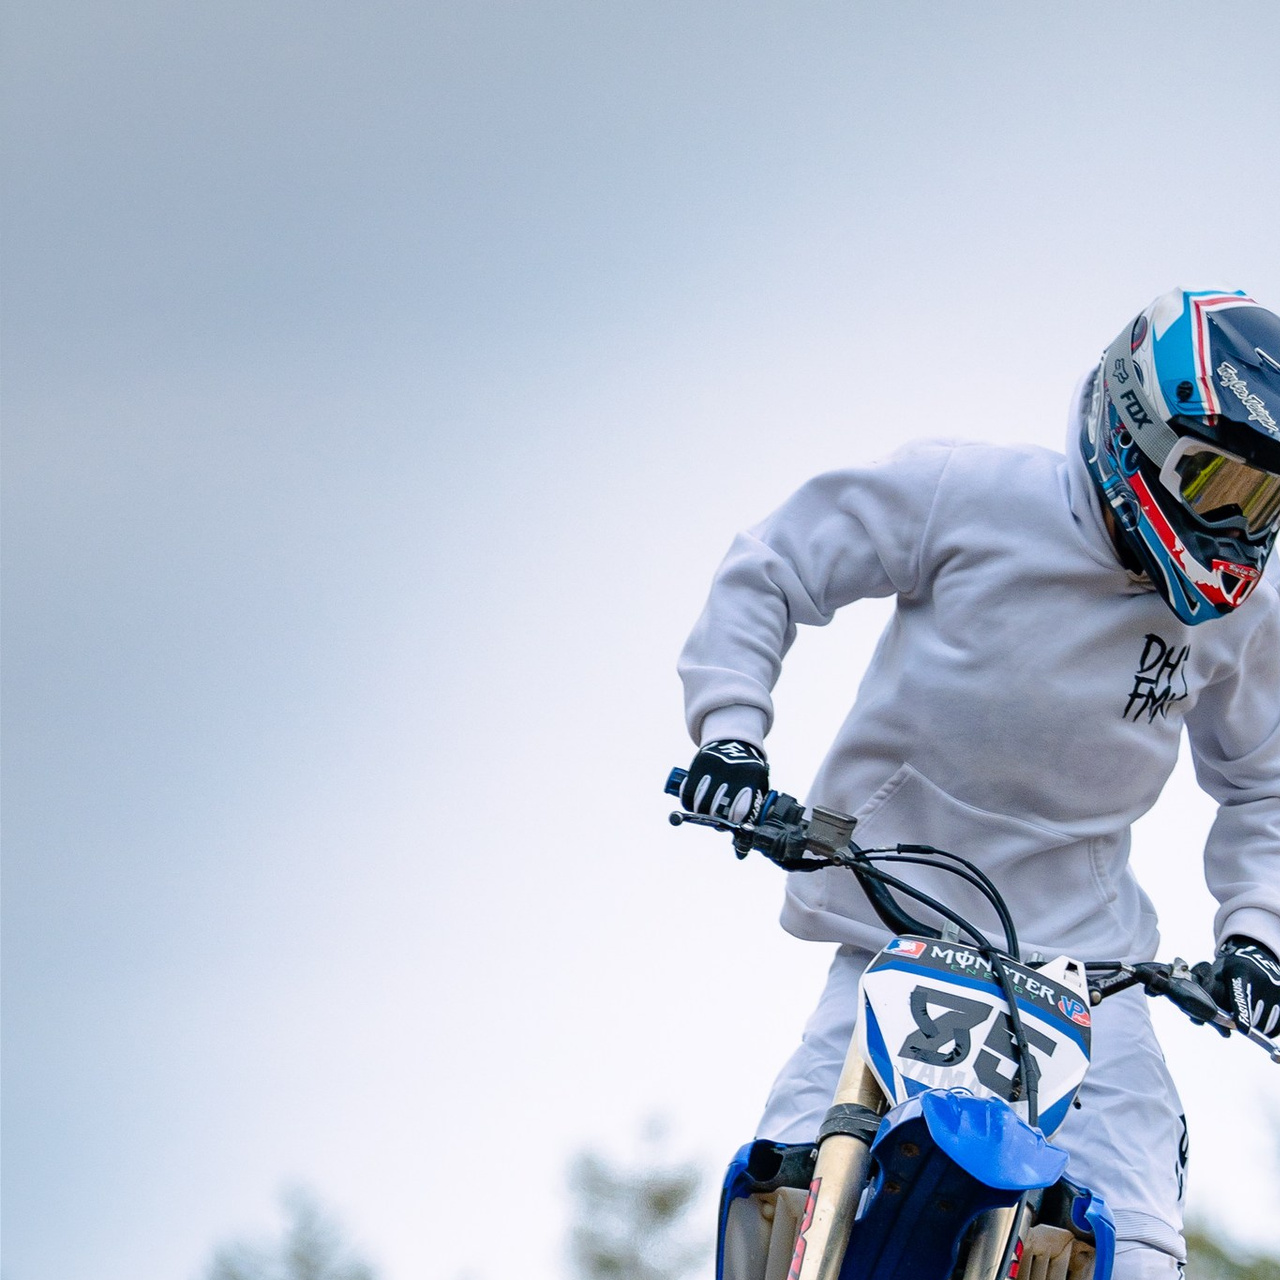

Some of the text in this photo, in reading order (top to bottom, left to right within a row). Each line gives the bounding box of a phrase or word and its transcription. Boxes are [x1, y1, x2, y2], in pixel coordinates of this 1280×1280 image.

[1120, 388, 1154, 430] FOX
[931, 946, 1056, 1006] MONTER
[950, 964, 1037, 1000] ENEGY
[1060, 994, 1085, 1020] VP
[897, 985, 1057, 1102] 85
